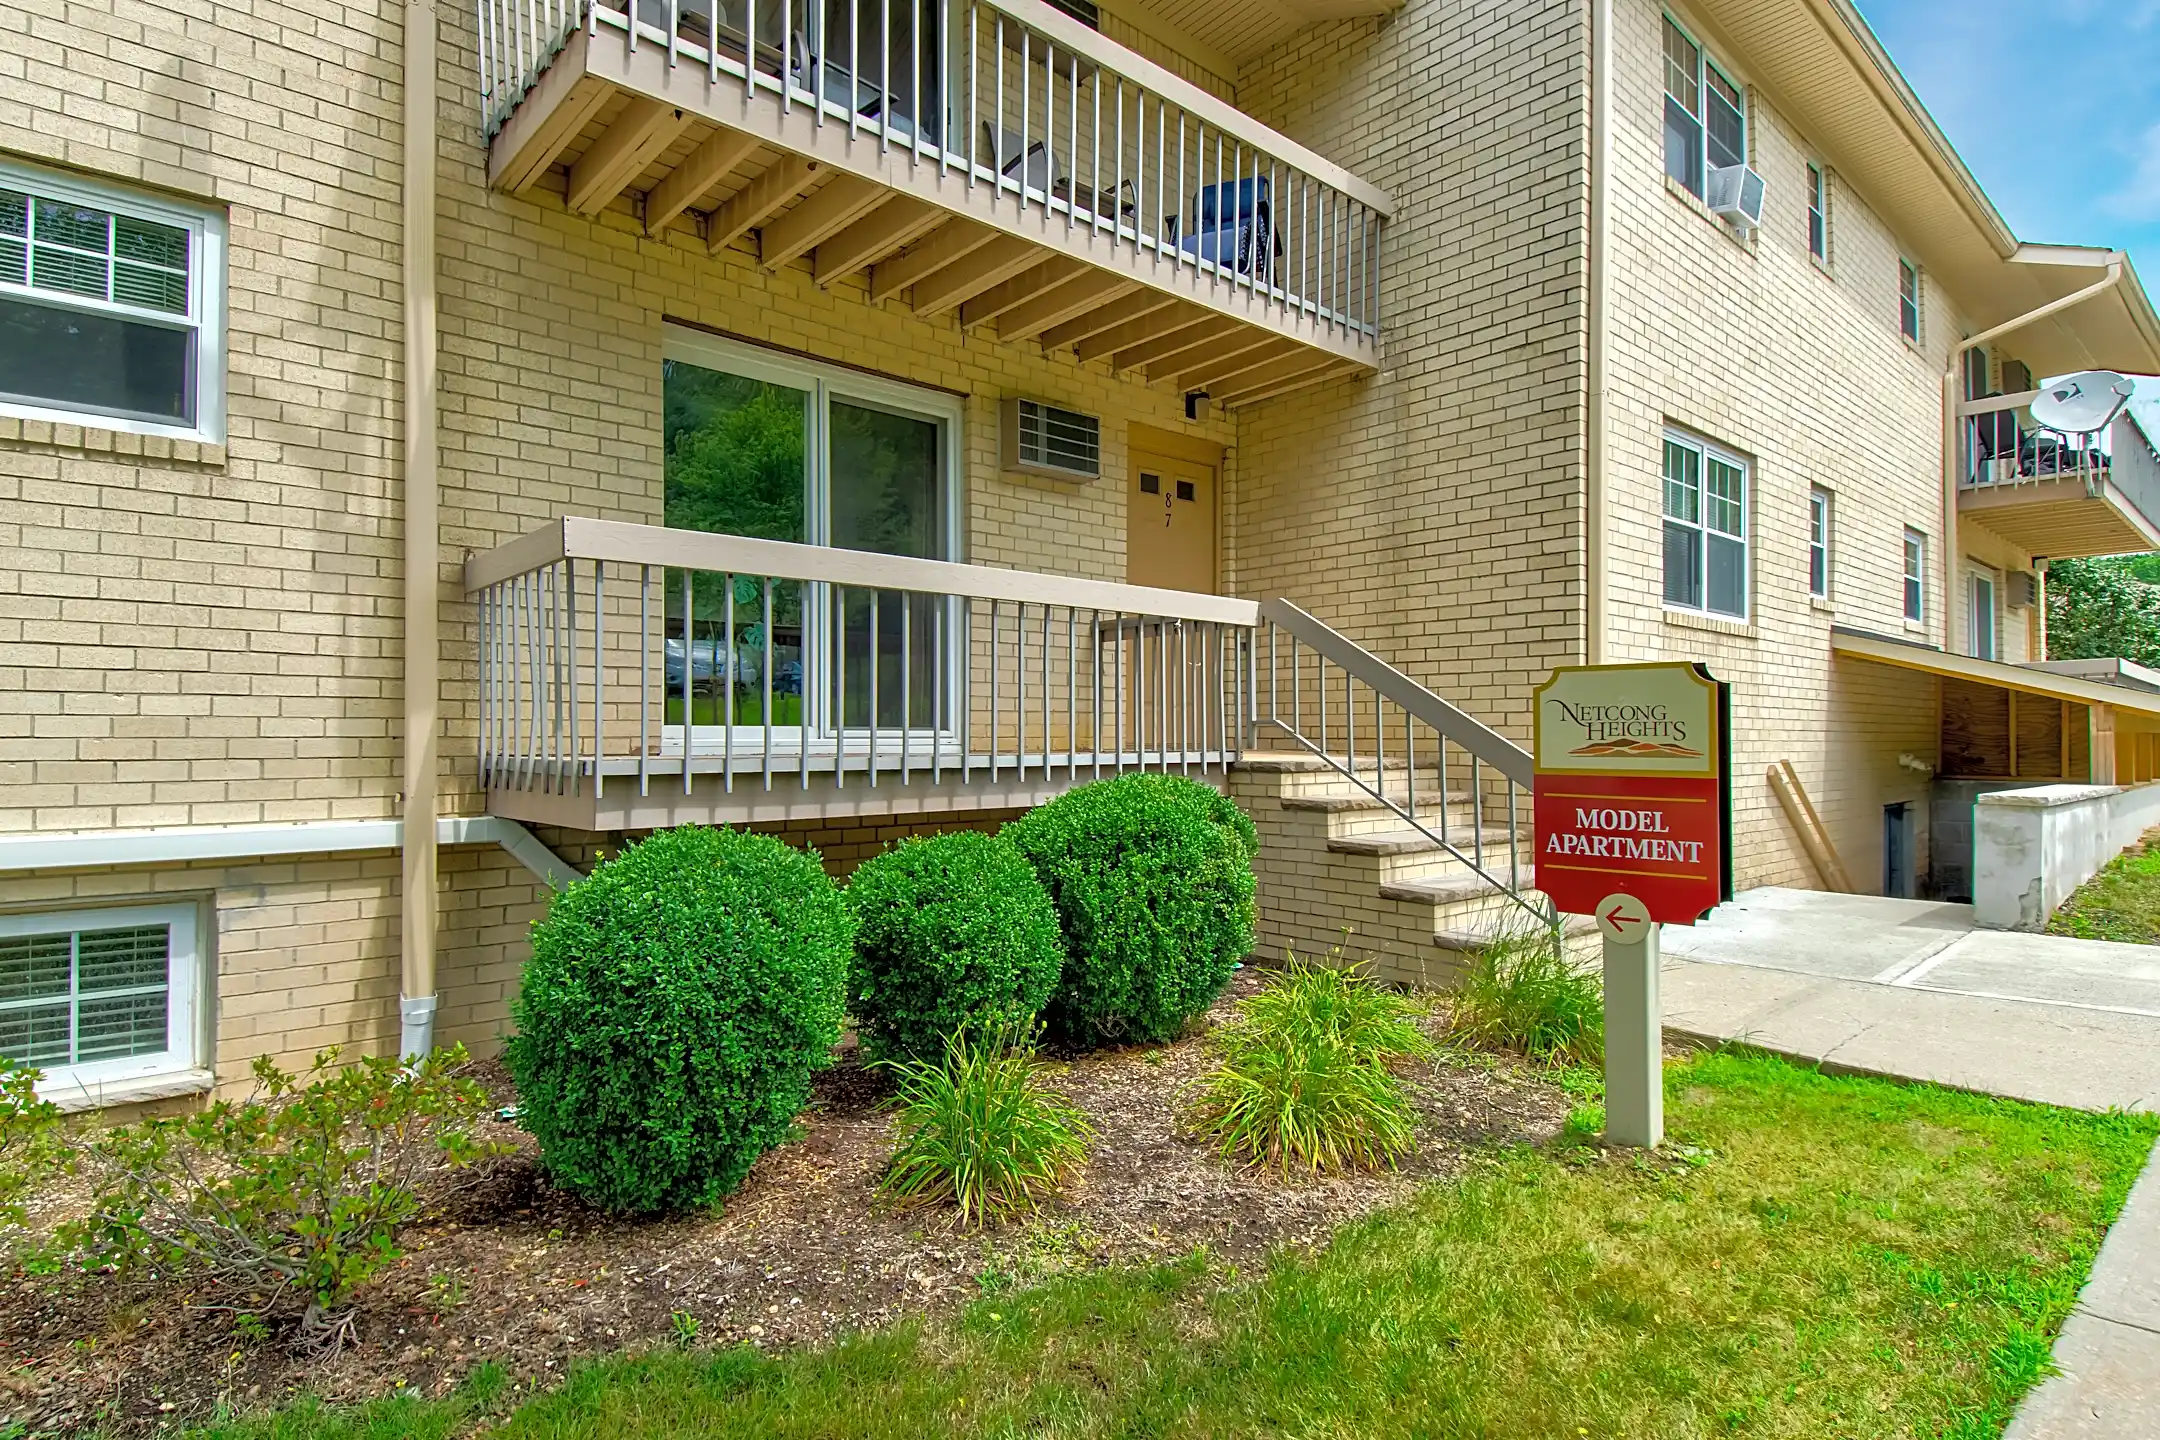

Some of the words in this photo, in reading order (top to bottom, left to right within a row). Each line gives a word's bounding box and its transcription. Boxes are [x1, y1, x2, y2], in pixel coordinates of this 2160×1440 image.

[1165, 492, 1172, 508] 8
[1165, 513, 1172, 528] 7
[1546, 699, 1667, 727] NETCONG
[1586, 720, 1687, 742] HEIGHTS
[1575, 808, 1670, 833] MODEL
[1546, 832, 1704, 864] APARTMENT
